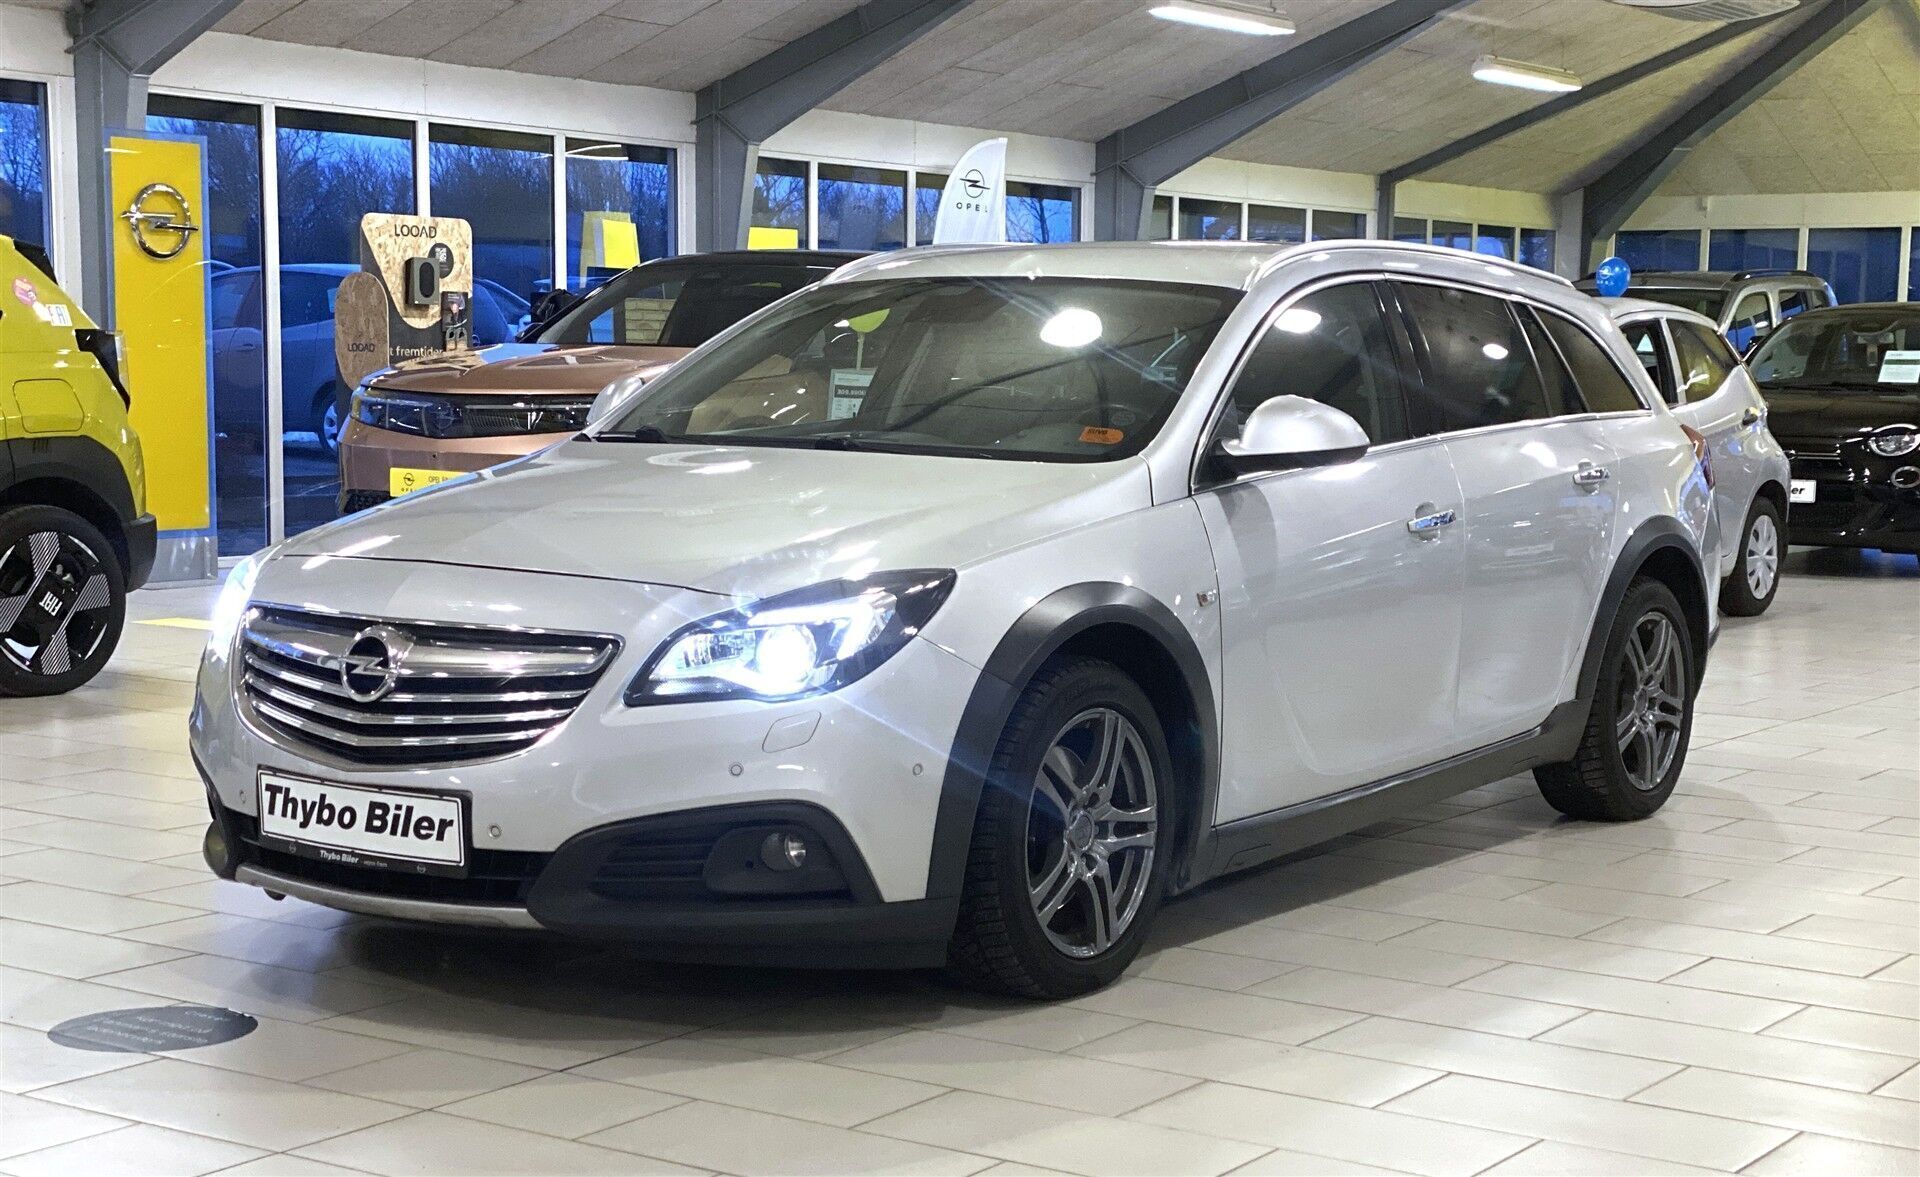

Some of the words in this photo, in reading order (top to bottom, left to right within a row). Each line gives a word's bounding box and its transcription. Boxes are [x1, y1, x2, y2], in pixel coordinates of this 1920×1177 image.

[956, 202, 988, 213] OPEL
[394, 224, 437, 239] LOOAD
[347, 342, 376, 353] LOOAD
[1791, 487, 1805, 495] er
[39, 591, 63, 617] FIAT
[264, 783, 358, 830] Thybo
[364, 800, 454, 842] Biler
[320, 849, 341, 861] Thybo
[341, 853, 359, 864] Biler
